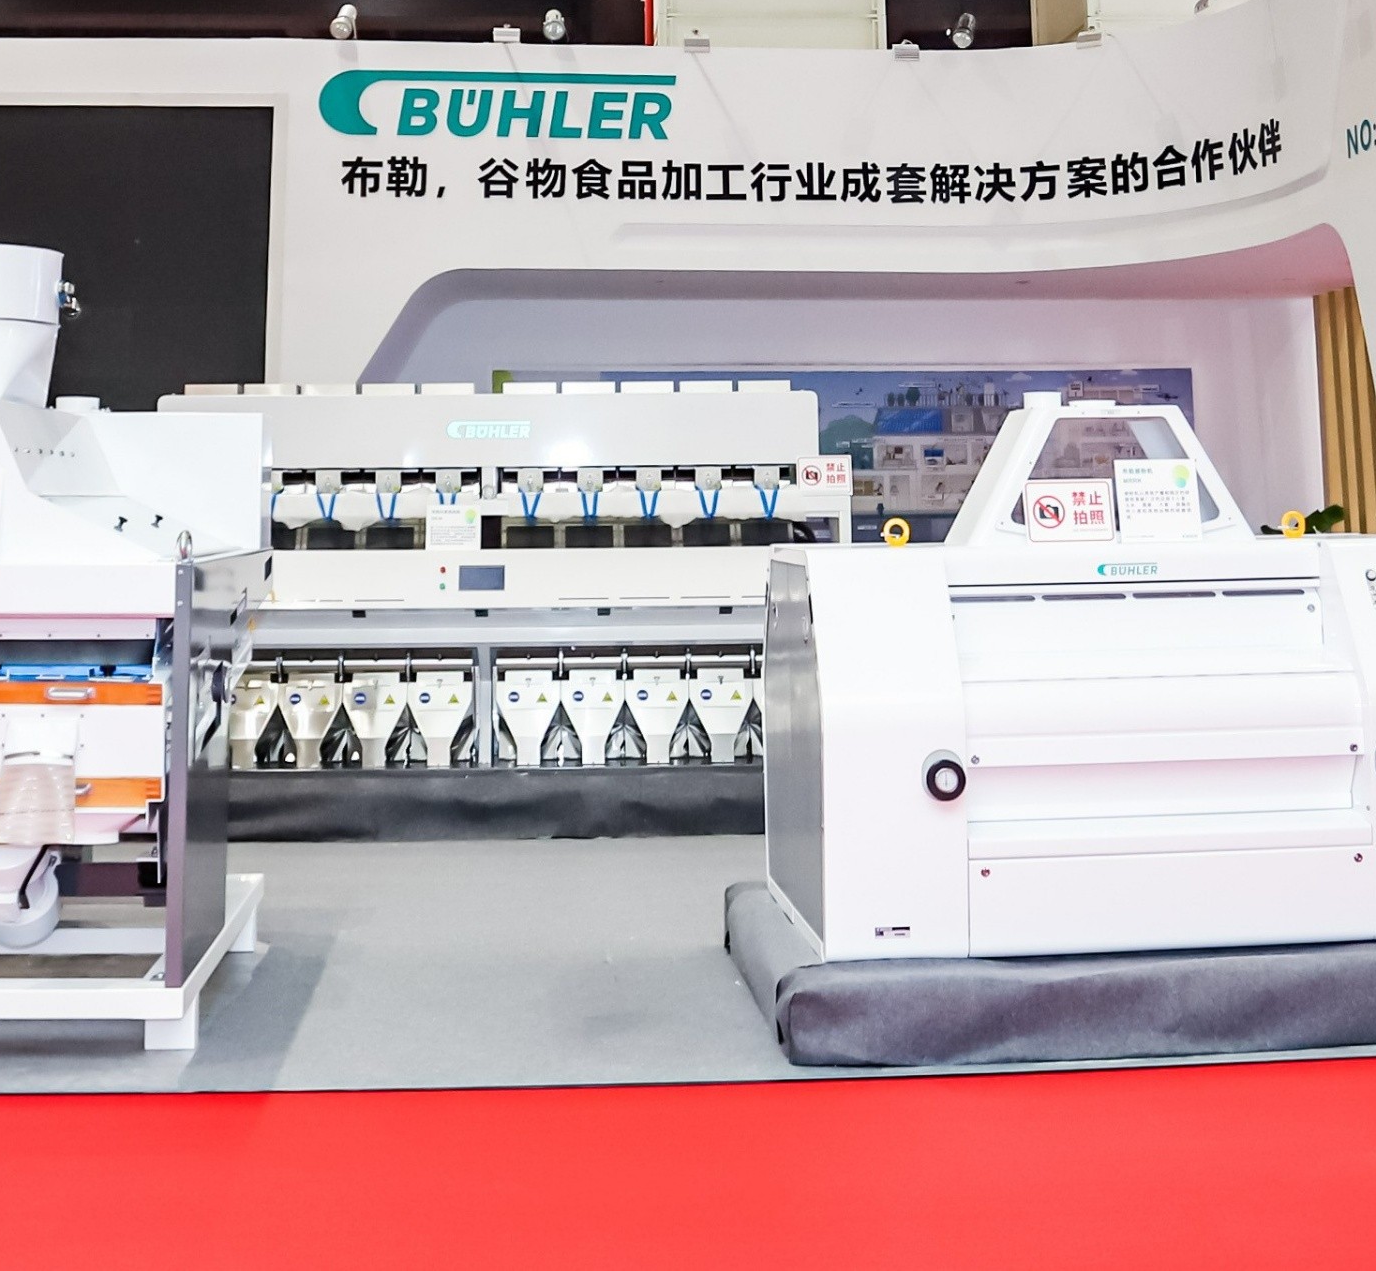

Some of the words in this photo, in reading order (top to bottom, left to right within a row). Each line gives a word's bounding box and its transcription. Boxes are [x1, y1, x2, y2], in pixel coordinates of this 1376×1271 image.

[396, 84, 673, 141] BÜHLER
[340, 118, 1283, 204] 布勒，谷物食品加工行业成套解决方案的合作伙伴
[826, 462, 845, 472] 禁止
[826, 474, 846, 484] 拍照
[1072, 491, 1103, 506] 禁止
[1074, 510, 1105, 525] 拍照
[1111, 565, 1159, 576] BÜHLER
